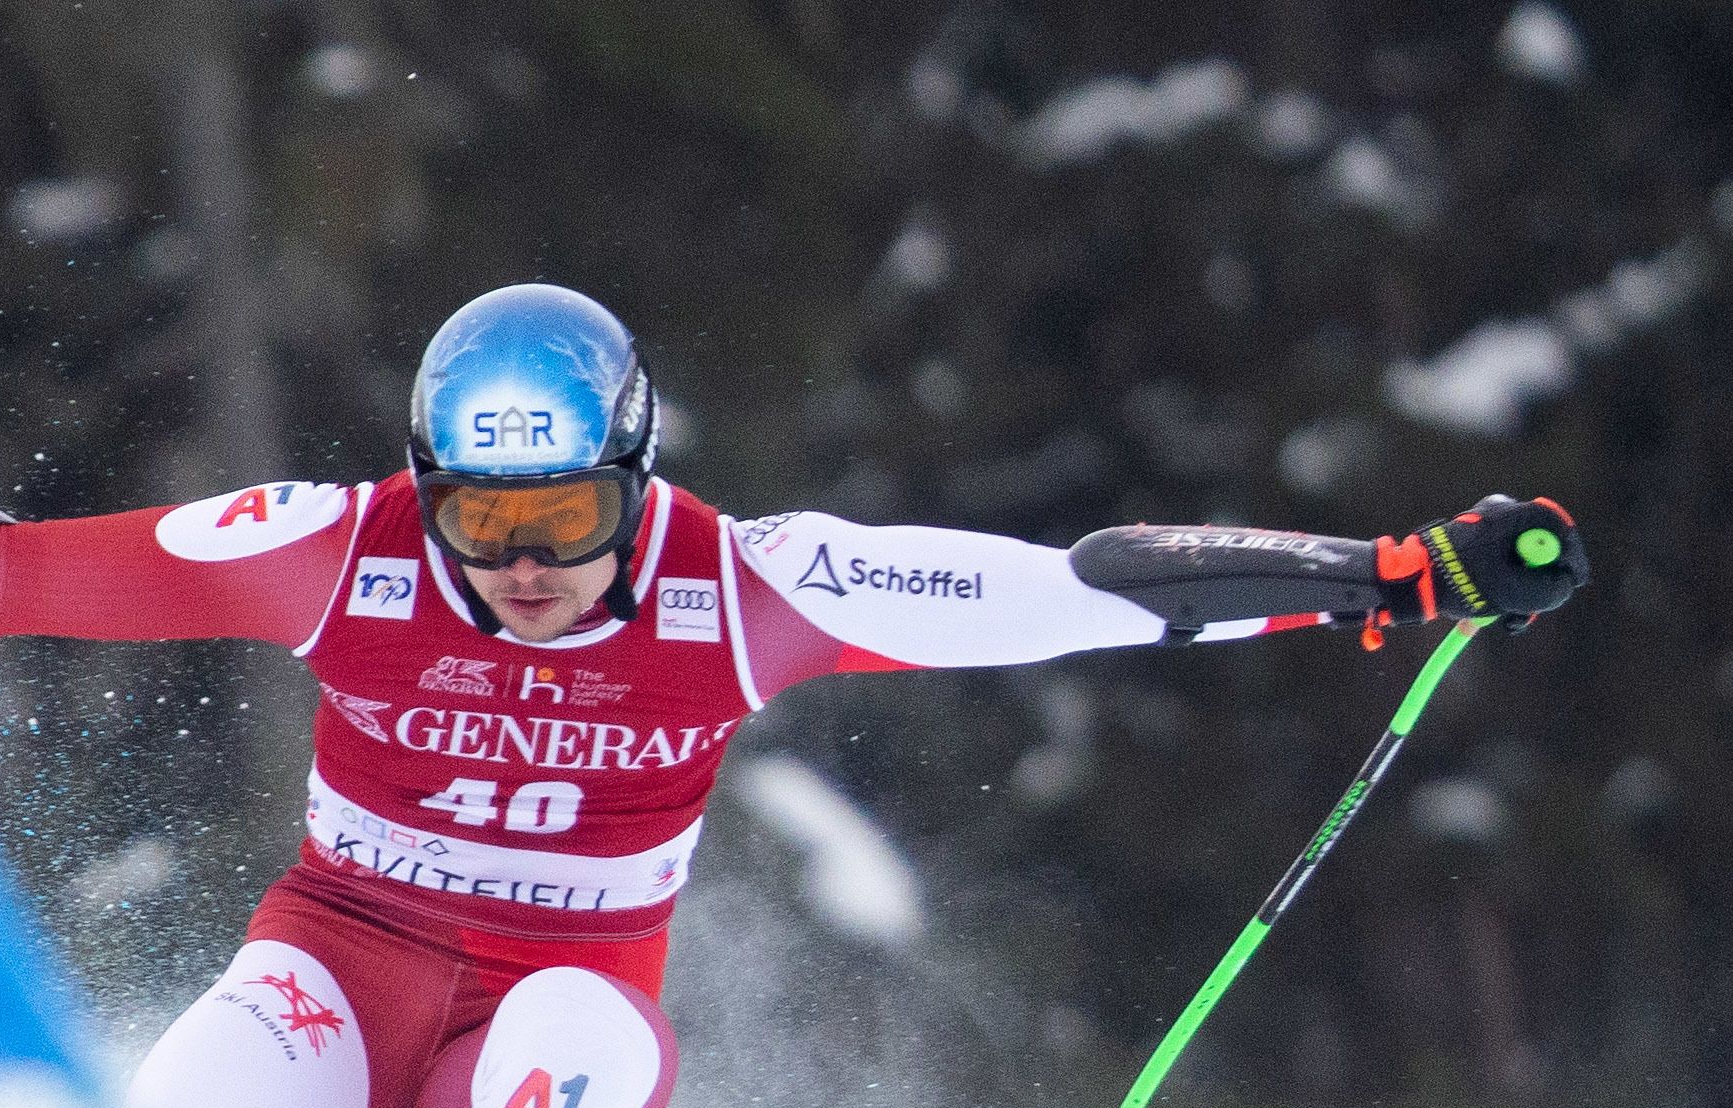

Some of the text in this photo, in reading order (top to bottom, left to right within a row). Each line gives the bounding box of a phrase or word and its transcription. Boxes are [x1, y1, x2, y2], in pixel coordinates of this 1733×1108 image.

[473, 405, 556, 448] SAR
[215, 483, 297, 528] A1
[419, 777, 586, 834] 40
